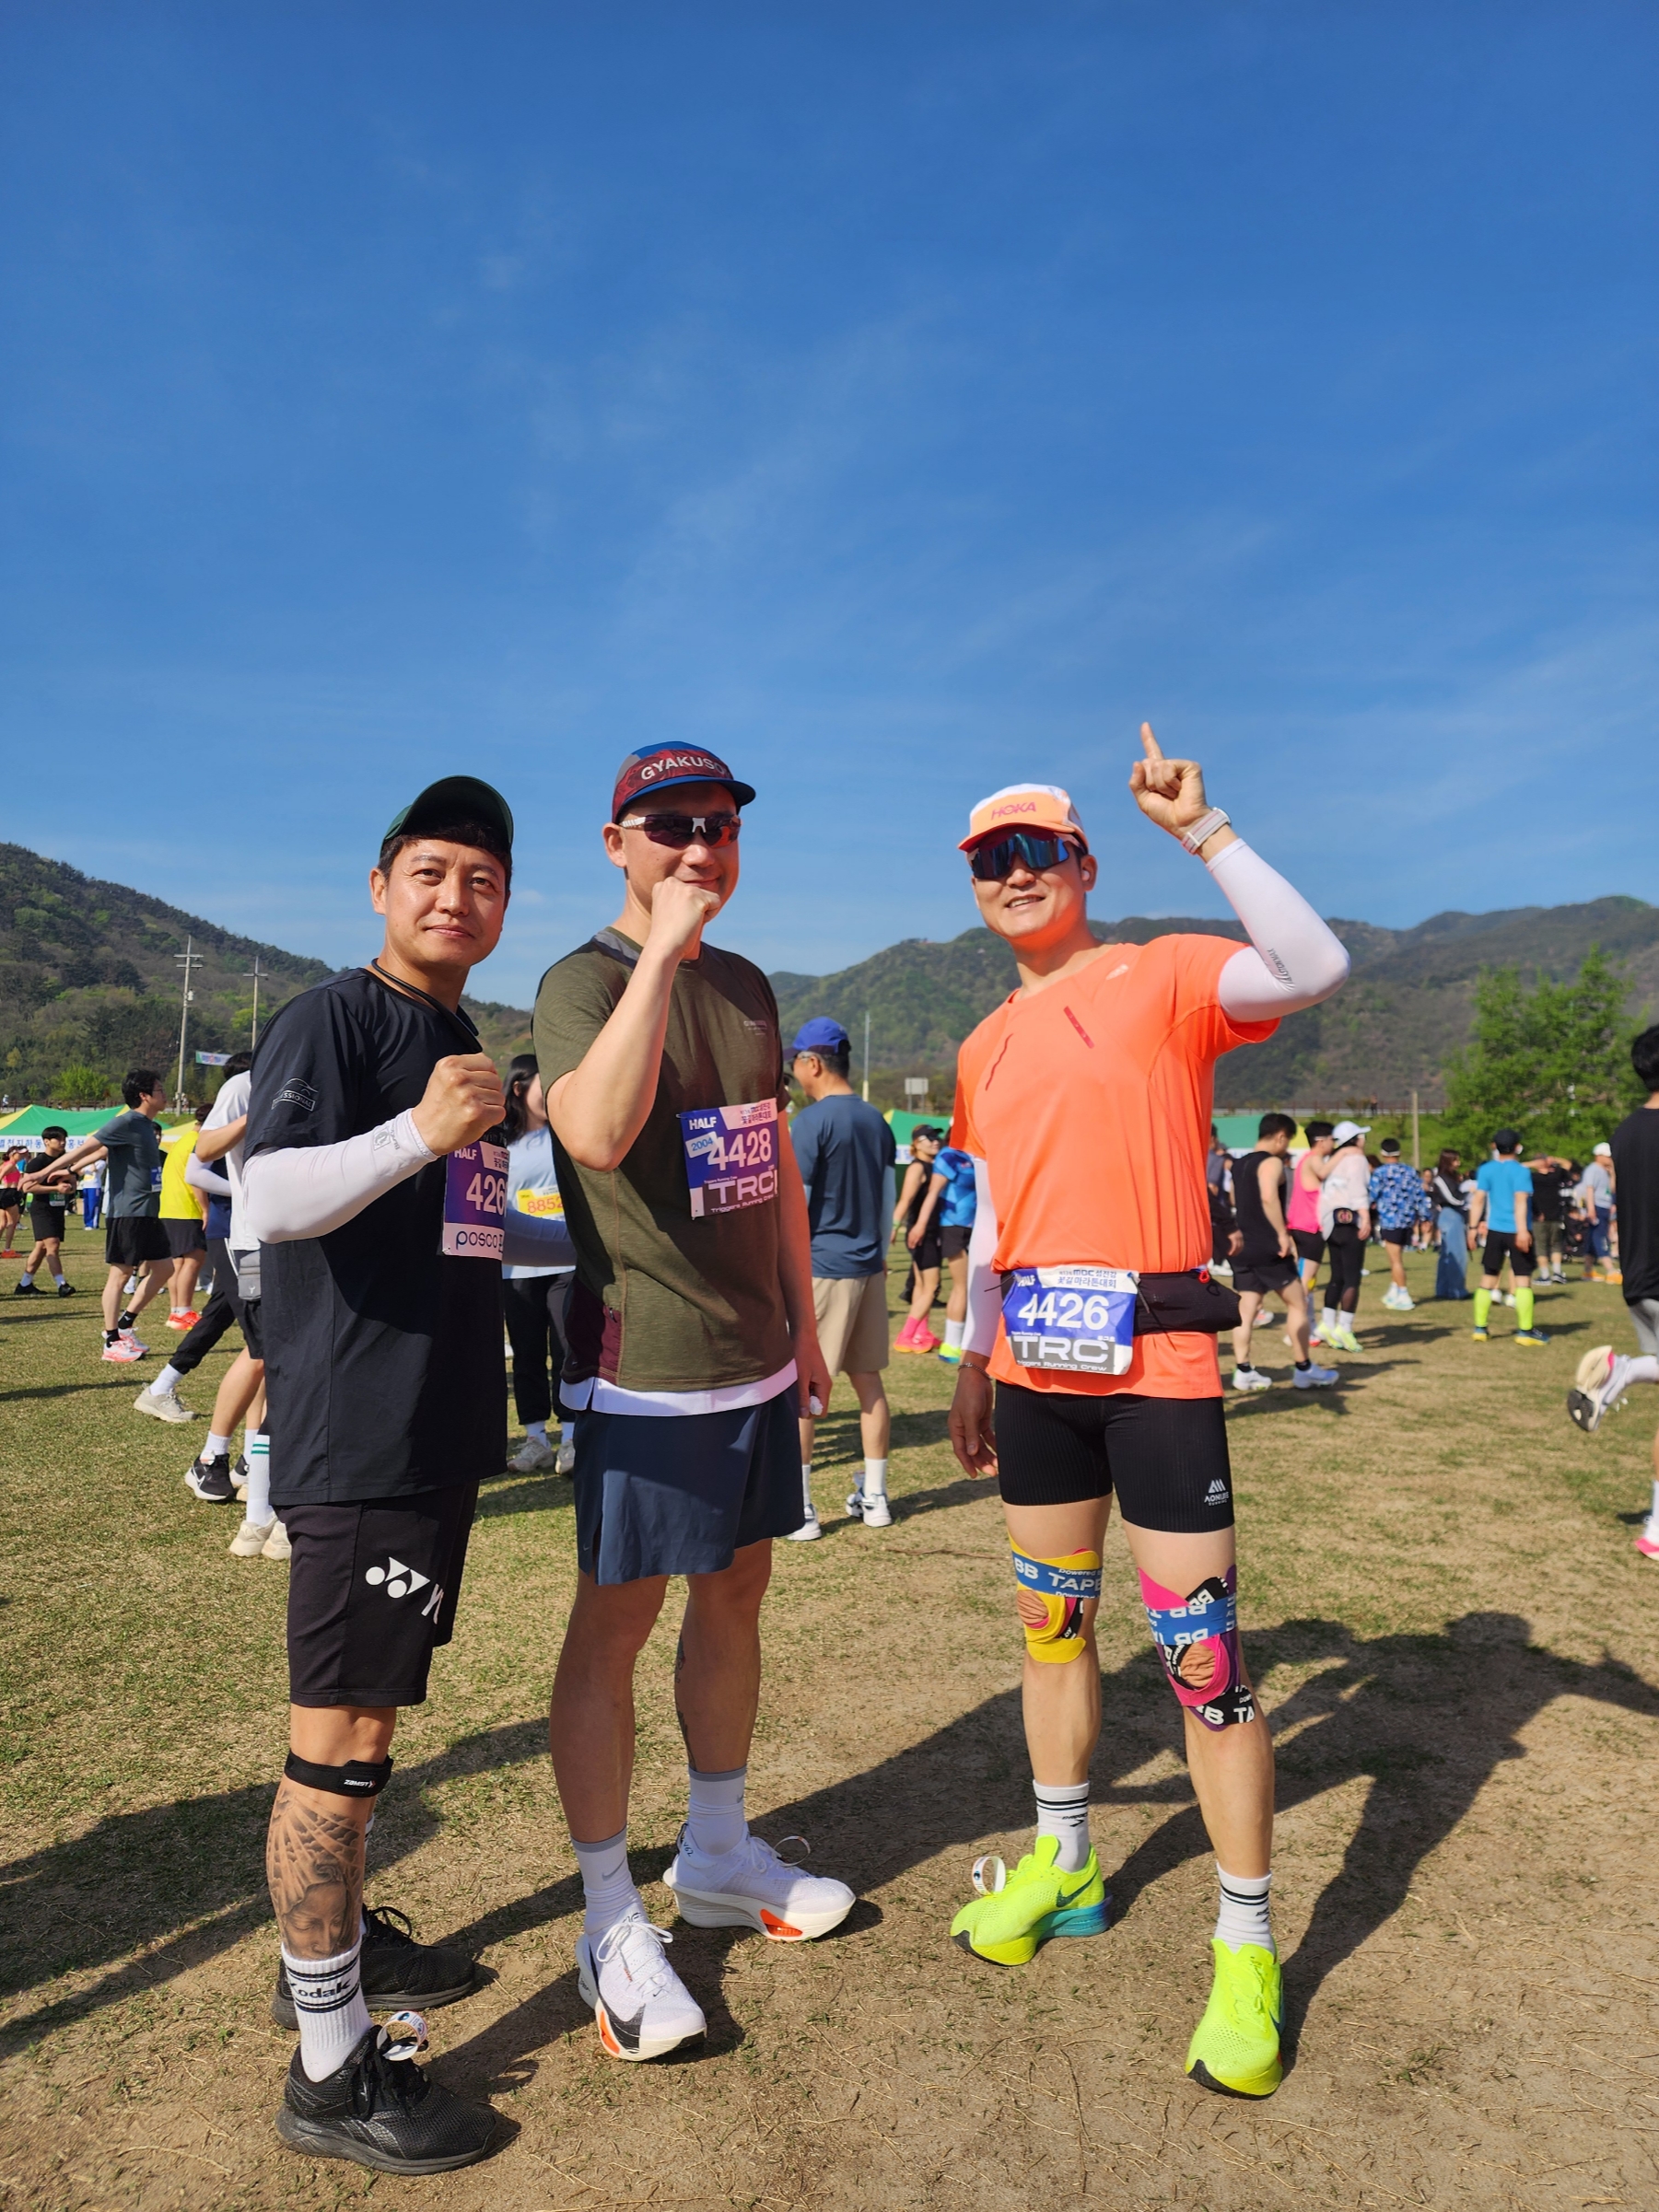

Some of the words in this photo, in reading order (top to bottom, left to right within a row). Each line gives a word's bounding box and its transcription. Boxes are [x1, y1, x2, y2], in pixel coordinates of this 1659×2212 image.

[991, 802, 1036, 821] HOKA
[689, 1116, 717, 1130] HALF
[454, 1148, 477, 1160] HALF
[691, 1137, 714, 1152] 2004
[707, 1128, 772, 1170] 4428
[465, 1172, 507, 1217] 426
[708, 1170, 774, 1205] TRC
[456, 1230, 497, 1251] posco
[1018, 1292, 1110, 1331] 4426
[1013, 1336, 1109, 1364] TRC
[1044, 1361, 1078, 1369] Running
[1081, 1364, 1108, 1372] Crew
[1014, 1557, 1039, 1579] BB
